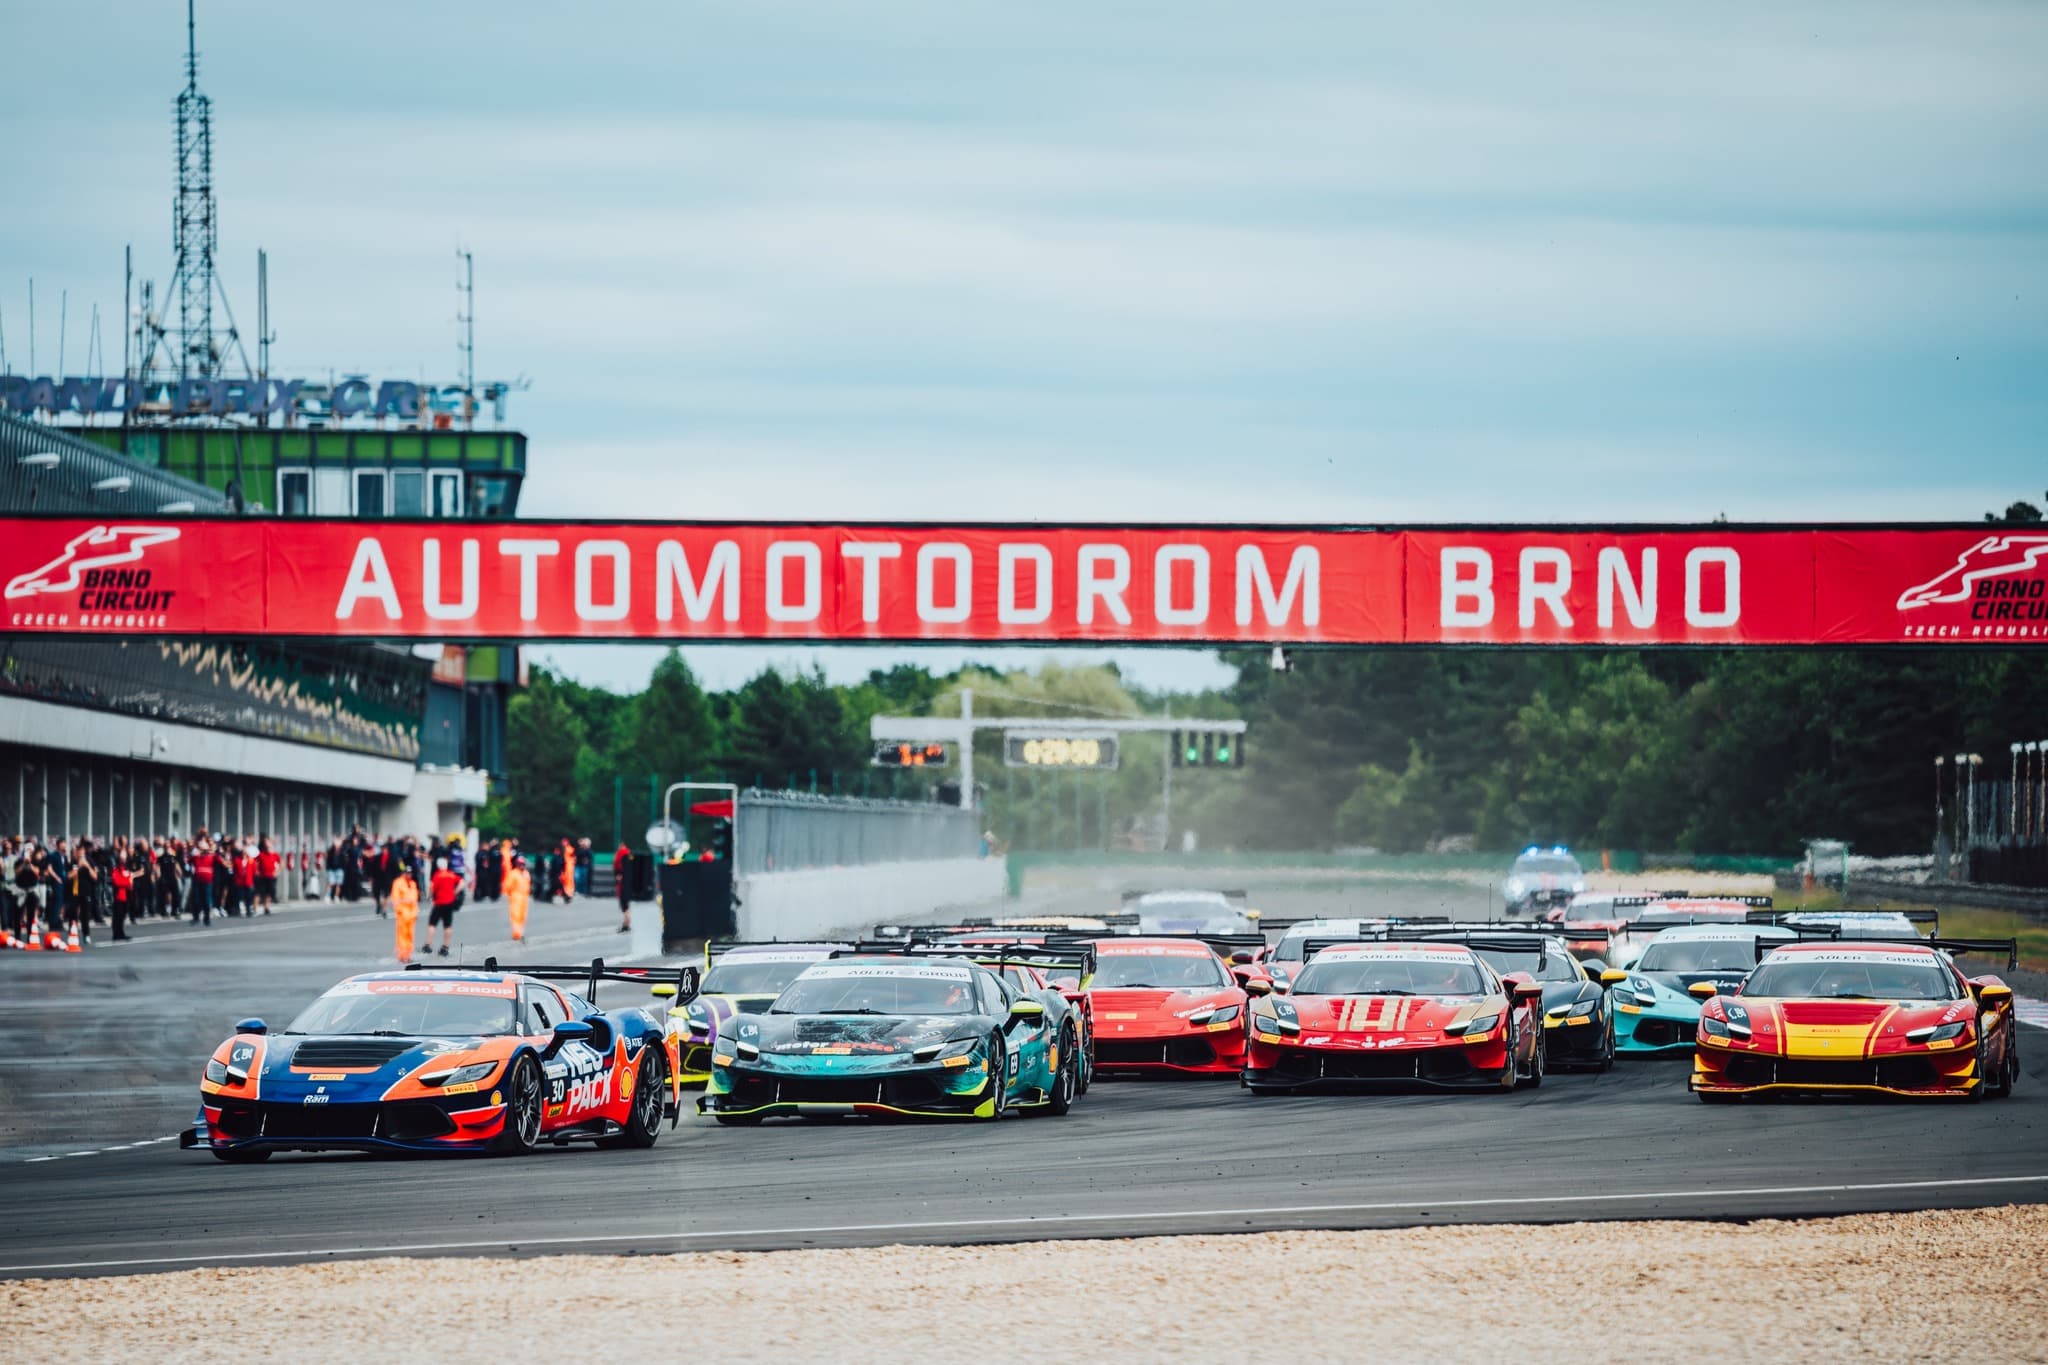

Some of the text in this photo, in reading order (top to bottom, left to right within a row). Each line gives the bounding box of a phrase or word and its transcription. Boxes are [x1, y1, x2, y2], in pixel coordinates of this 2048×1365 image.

[85, 568, 152, 589] BRNO
[335, 537, 1742, 632] AUTOMOTODROM BRNO
[1976, 579, 2046, 599] BRNO
[78, 590, 175, 611] CIRCUIT
[12, 612, 167, 628] CZECH REPUBLIC
[1904, 624, 1960, 637] CZECH
[375, 985, 513, 996] ADLER GROUP
[551, 1079, 565, 1103] 30
[567, 1069, 614, 1116] PACK
